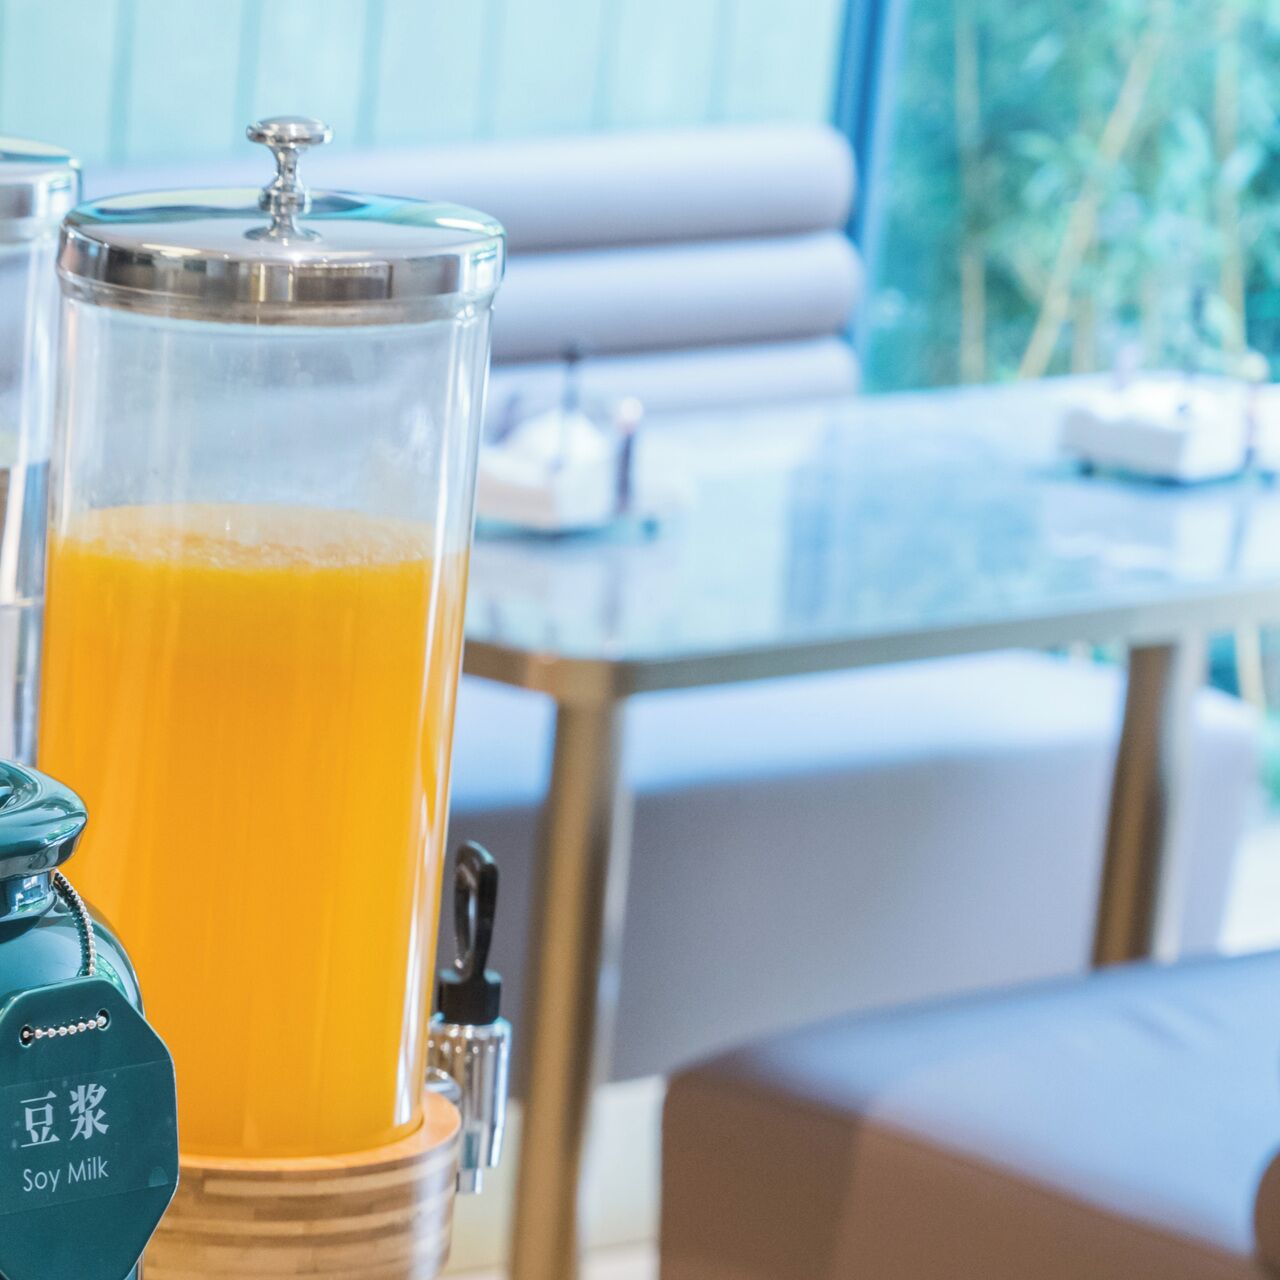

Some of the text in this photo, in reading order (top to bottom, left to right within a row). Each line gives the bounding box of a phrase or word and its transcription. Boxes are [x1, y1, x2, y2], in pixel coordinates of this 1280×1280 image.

[19, 1083, 110, 1148] 豆浆
[23, 1156, 109, 1193] Soy Milk
